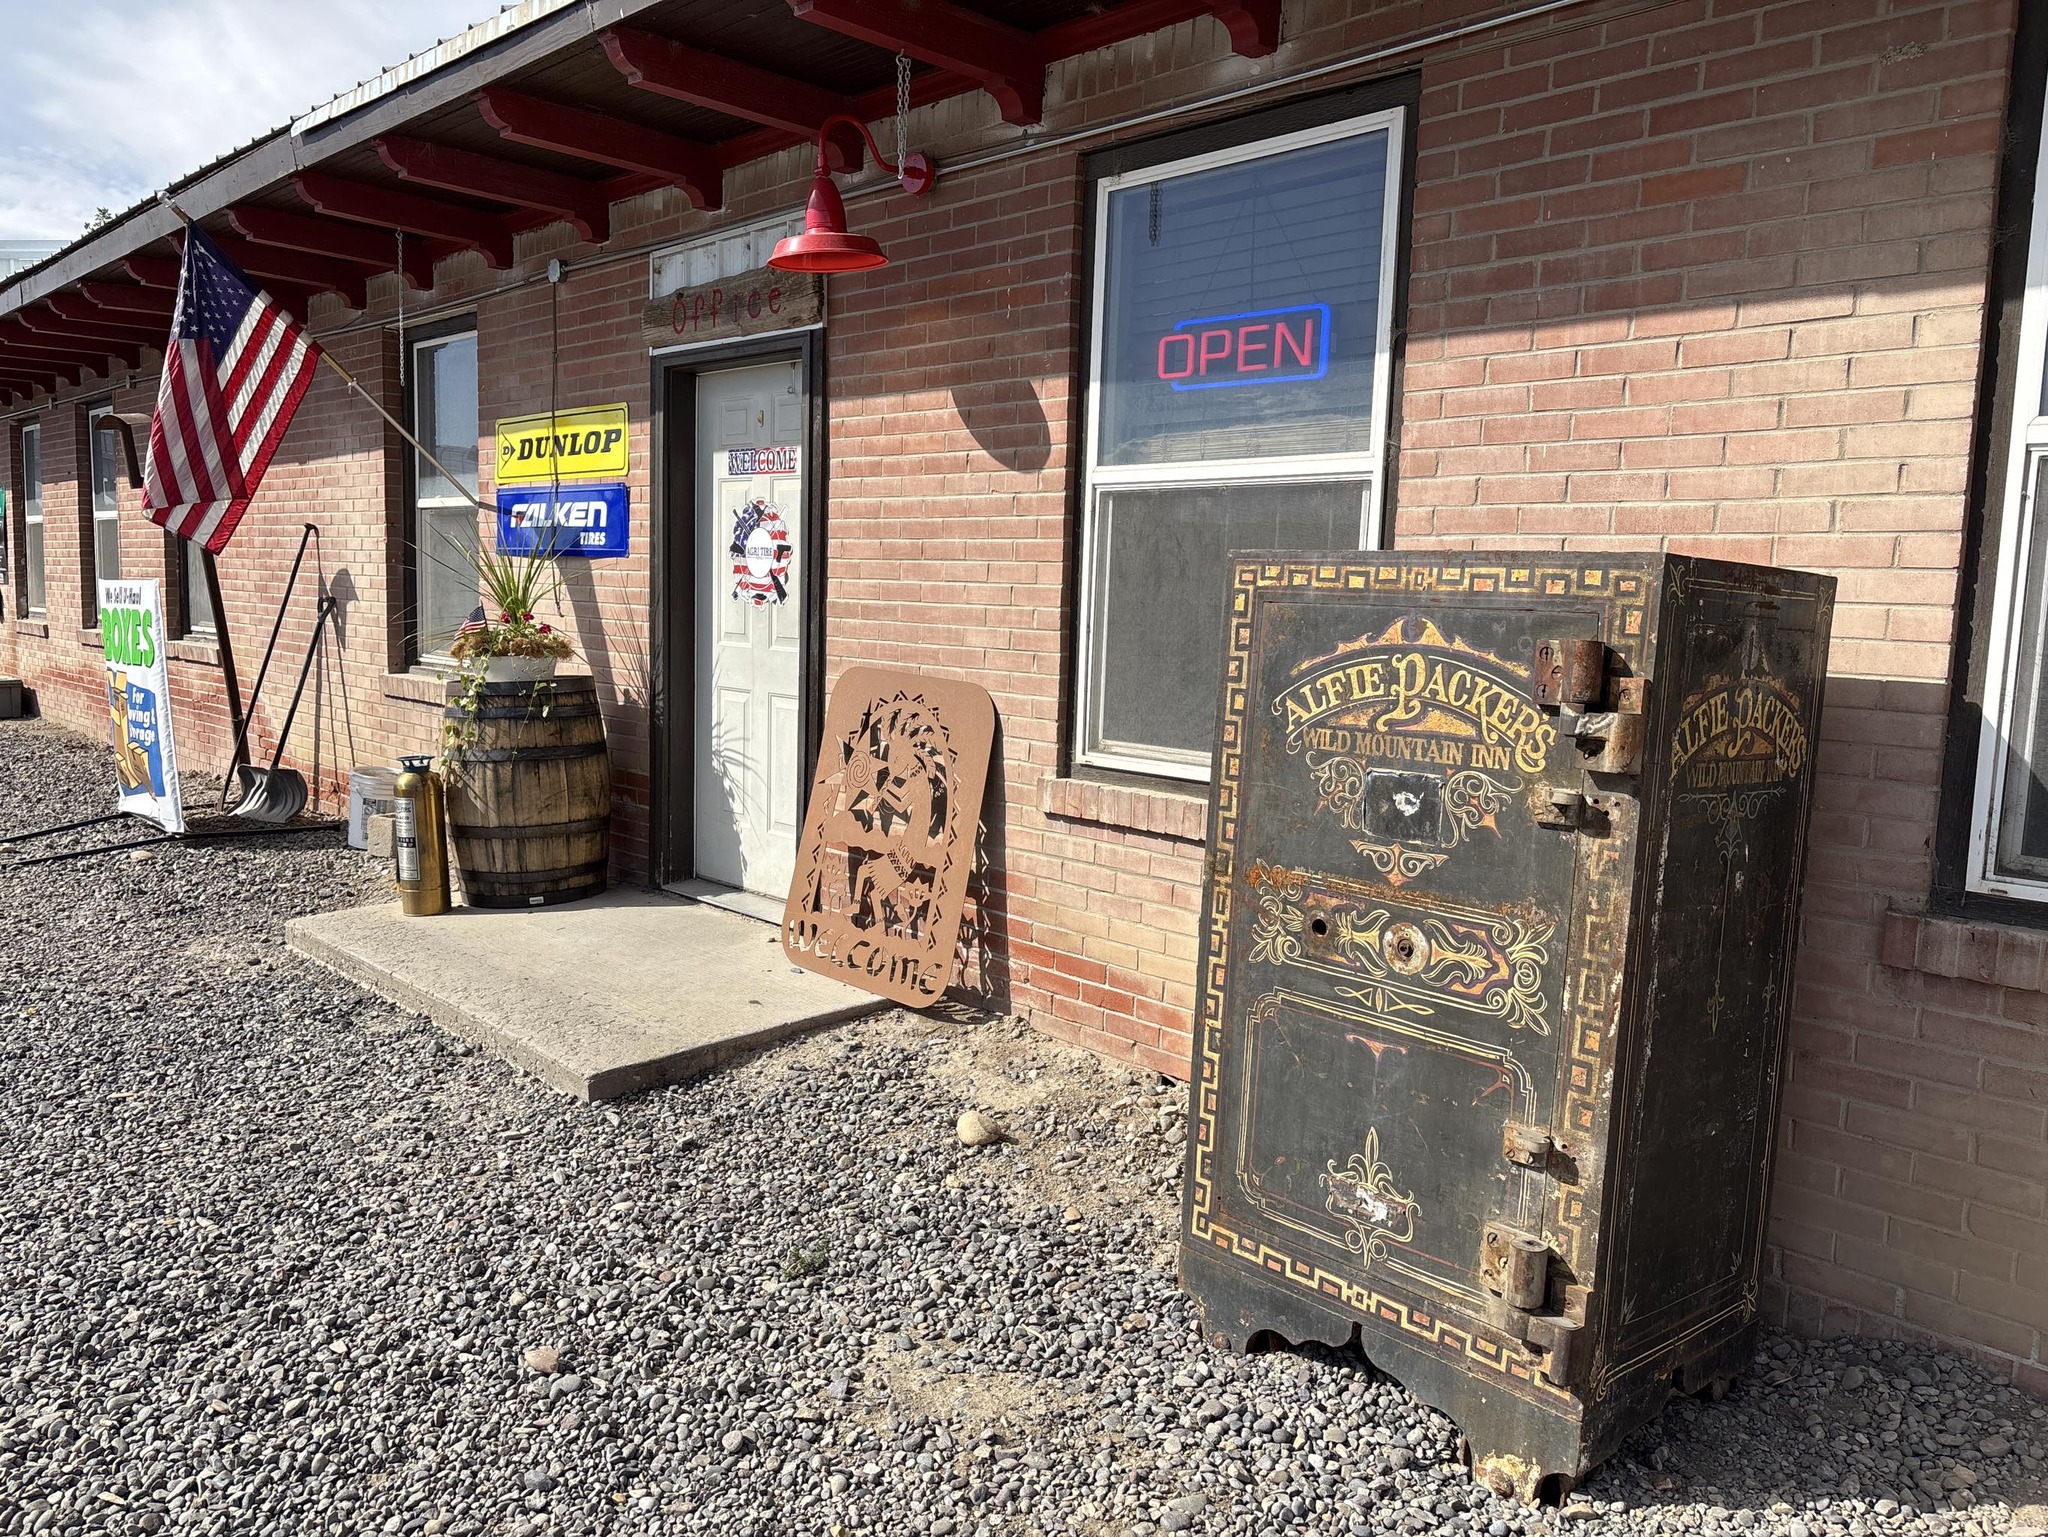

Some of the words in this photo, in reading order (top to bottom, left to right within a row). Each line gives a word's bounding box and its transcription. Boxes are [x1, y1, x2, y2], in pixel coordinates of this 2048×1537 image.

[1157, 318, 1314, 380] OPEN
[517, 427, 622, 461] DUNLOP
[729, 449, 797, 474] WELCOME
[510, 501, 608, 528] FALKEN
[579, 531, 606, 546] TIRES
[746, 546, 759, 556] AGRI
[760, 546, 773, 557] TIRE
[105, 587, 113, 604] We
[114, 586, 122, 605] Sell
[102, 607, 155, 668] BOXES
[132, 687, 145, 704] For
[1285, 662, 1386, 734] ALFIE
[129, 721, 155, 746] torage
[1670, 691, 1729, 781] ALFIE
[1302, 727, 1351, 752] WILD
[1355, 731, 1464, 766] MOUNTAIN
[1470, 744, 1512, 771] INN
[1686, 761, 1717, 789] WILD
